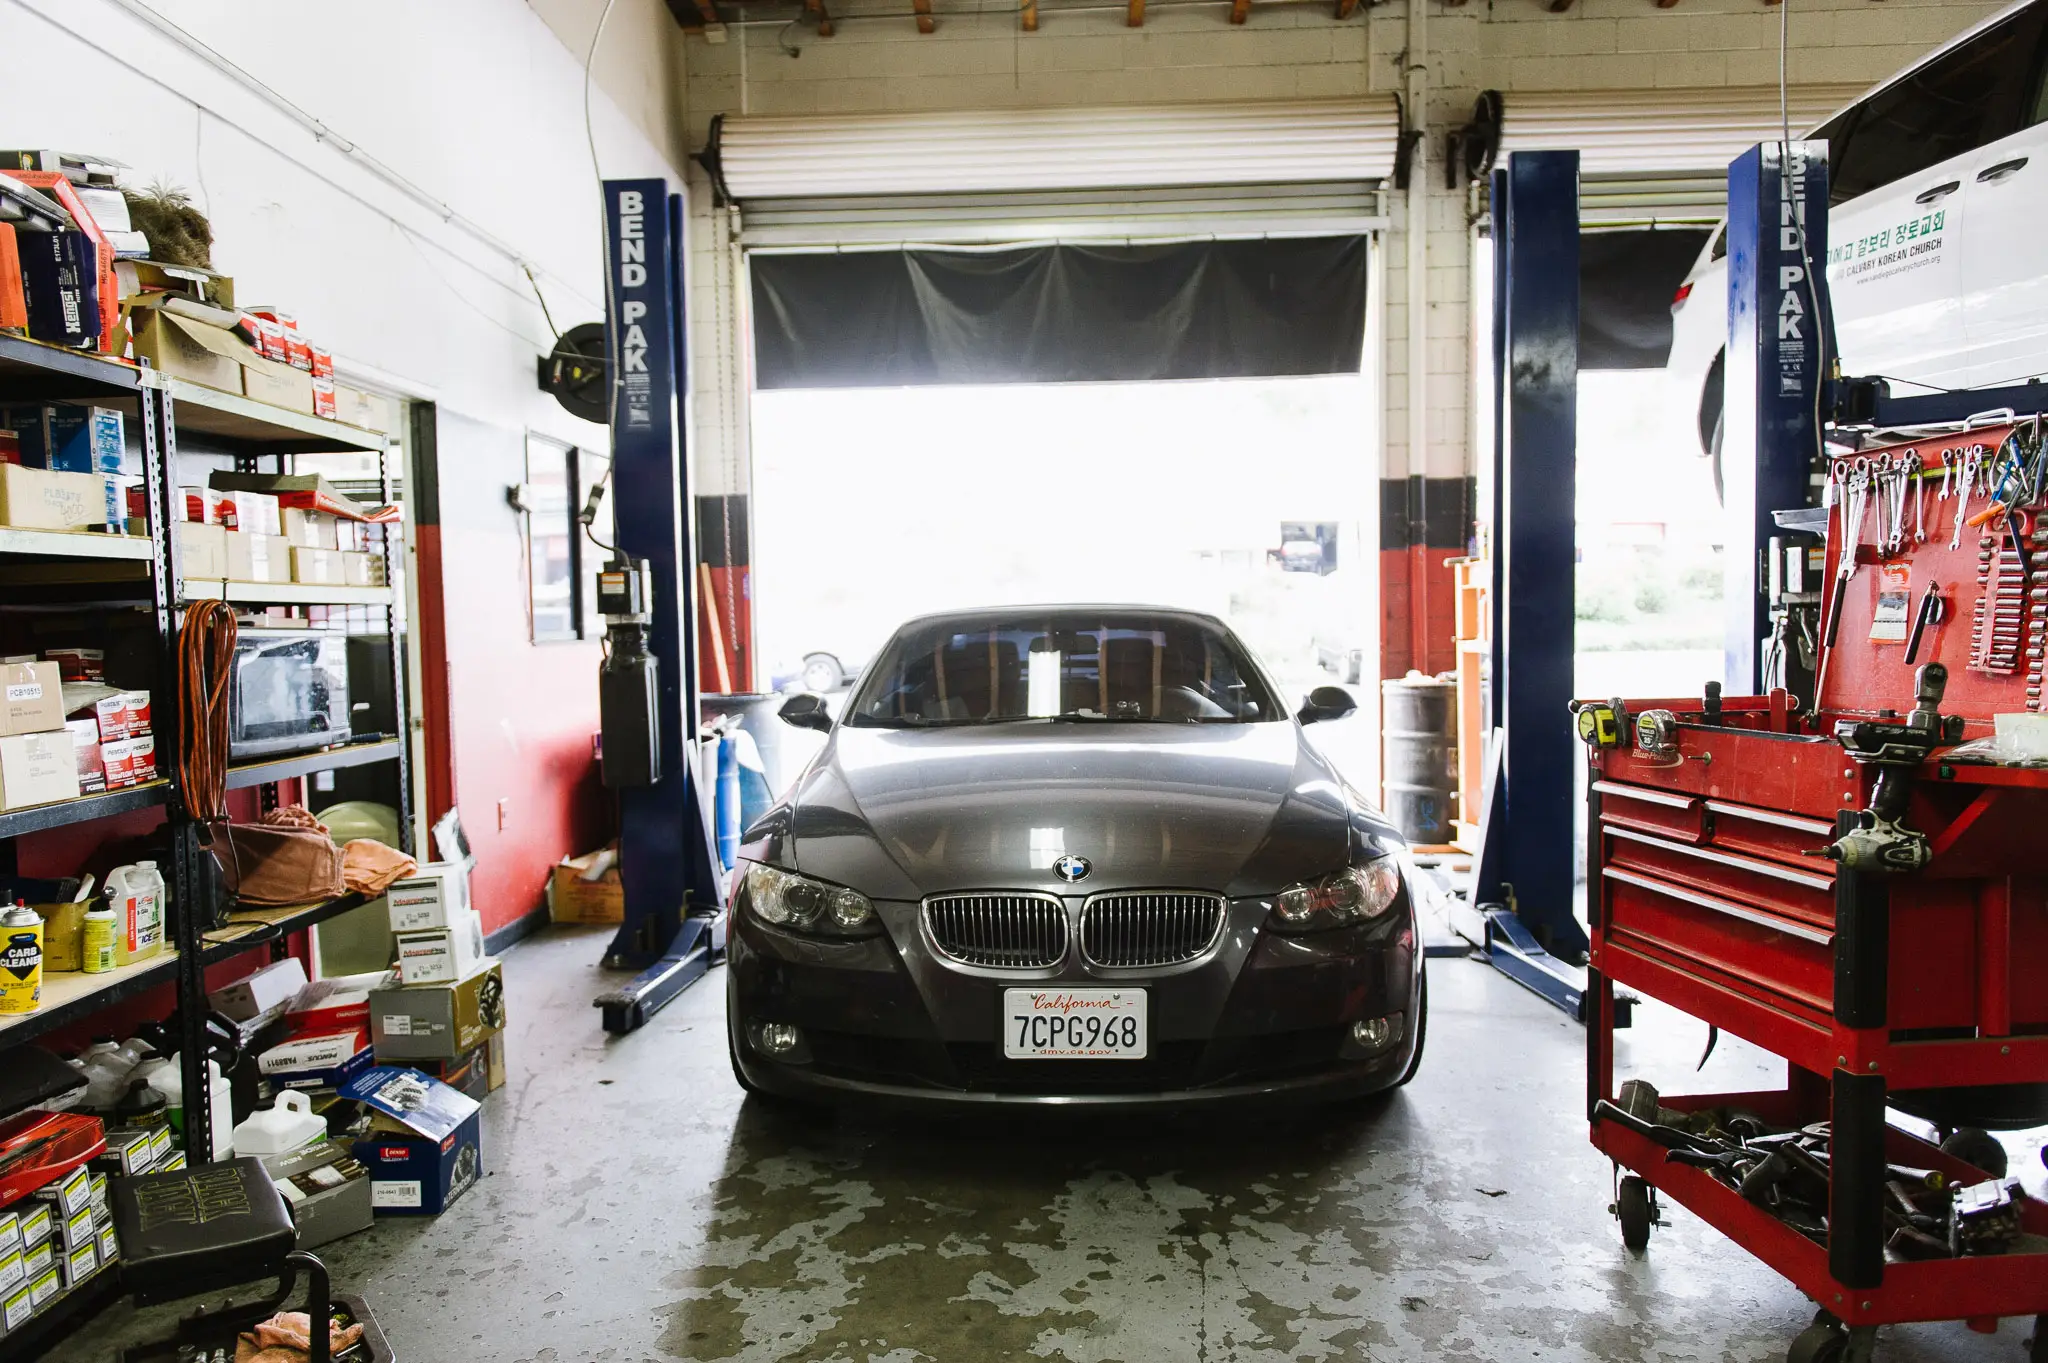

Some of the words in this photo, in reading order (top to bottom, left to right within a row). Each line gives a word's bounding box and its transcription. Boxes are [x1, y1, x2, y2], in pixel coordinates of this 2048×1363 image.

[52, 235, 62, 262] E173L01
[618, 190, 648, 288] BEND
[1857, 228, 1892, 258] 갈보리
[1895, 209, 1946, 245] 장로교회
[1846, 257, 1877, 278] CALVARY
[1878, 248, 1908, 268] KOREAN
[1909, 237, 1943, 257] CHURCH
[60, 287, 82, 334] Hengst
[1778, 266, 1805, 340] PAK
[622, 301, 649, 373] PAK
[8, 946, 38, 958] CARB
[1033, 993, 1120, 1014] California
[1014, 1015, 1137, 1048] 7CPG968
